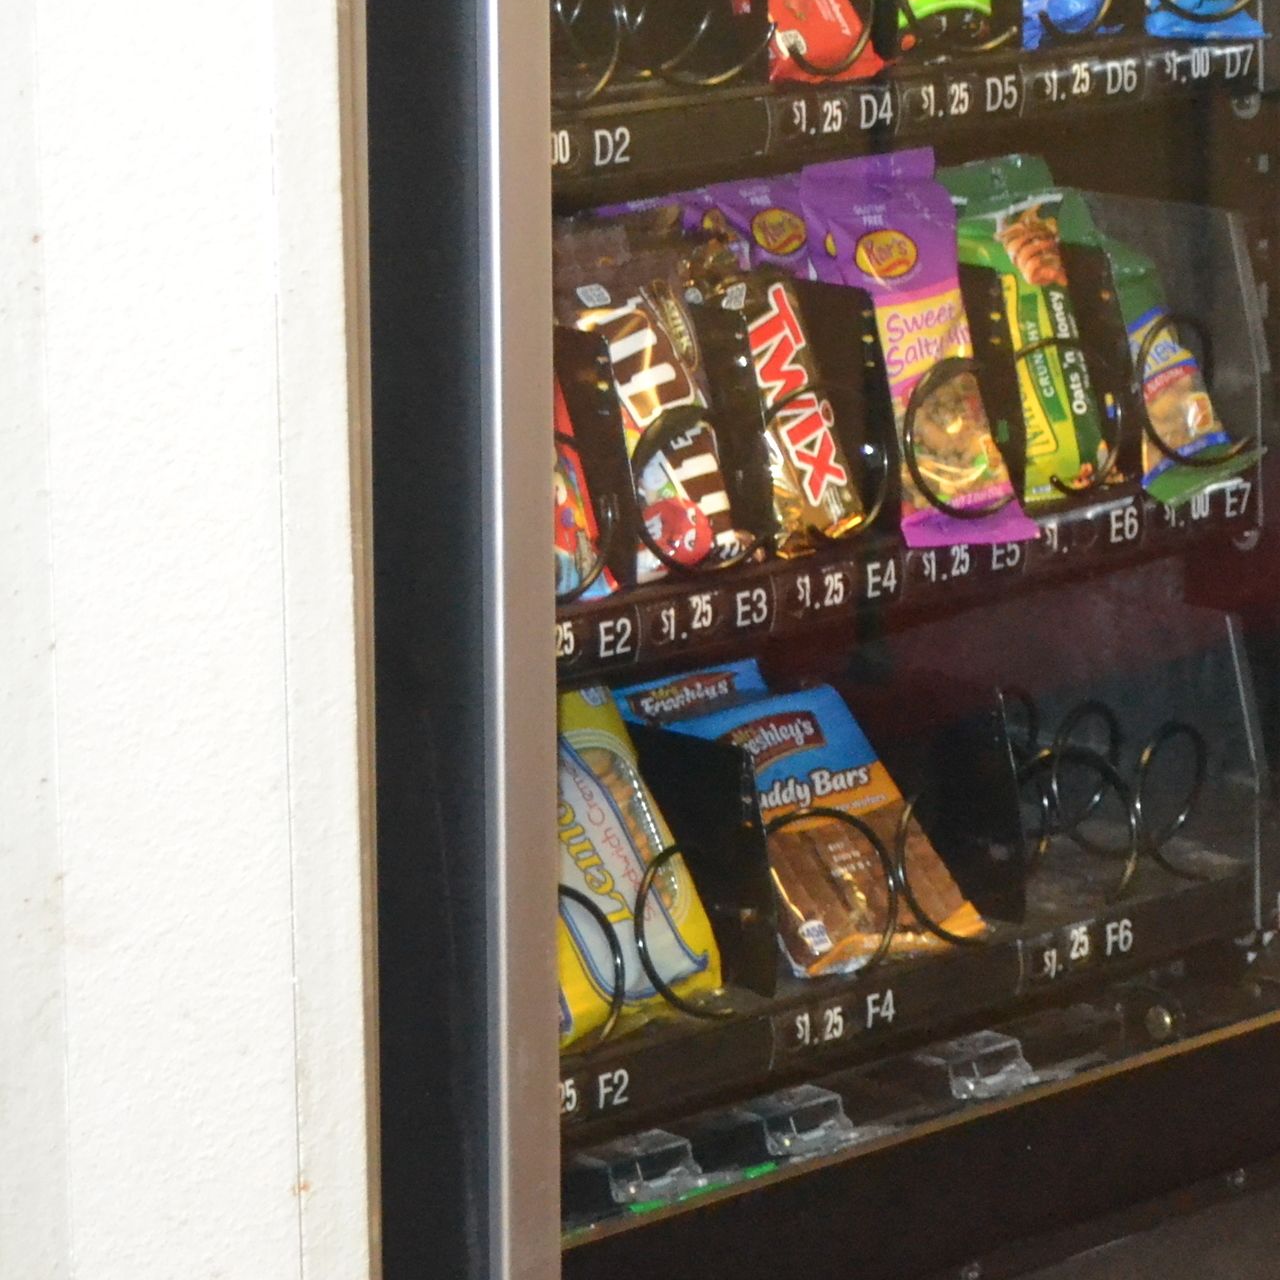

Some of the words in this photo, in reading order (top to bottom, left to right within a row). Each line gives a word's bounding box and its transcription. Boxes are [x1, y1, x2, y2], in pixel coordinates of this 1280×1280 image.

[1044, 62, 1090, 102] $1.25
[1106, 59, 1137, 95] D6
[1224, 44, 1254, 80] D7
[793, 99, 842, 135] $1.25
[859, 91, 893, 130] D4
[921, 82, 969, 118] $1.25
[986, 74, 1018, 113] D5
[594, 126, 630, 167] D2
[886, 302, 957, 343] Sweet
[884, 333, 945, 378] Salty
[1026, 320, 1055, 399] CRUNHY
[1069, 370, 1088, 415] Oats
[1224, 482, 1252, 518] E7
[1110, 505, 1139, 543] E6
[991, 543, 1020, 571] E5
[796, 572, 844, 610] $1.25
[866, 558, 897, 599] E4
[661, 594, 713, 640] $1.25
[736, 588, 768, 627] E3
[599, 617, 632, 658] E2
[760, 778, 811, 809] uddy
[810, 768, 868, 797] Bars
[559, 804, 634, 924] Lemo
[1043, 925, 1090, 979] $1.25
[1105, 918, 1133, 956] F6
[795, 1006, 844, 1045] $1.25
[866, 989, 896, 1028] F4
[598, 1069, 629, 1109] F2
